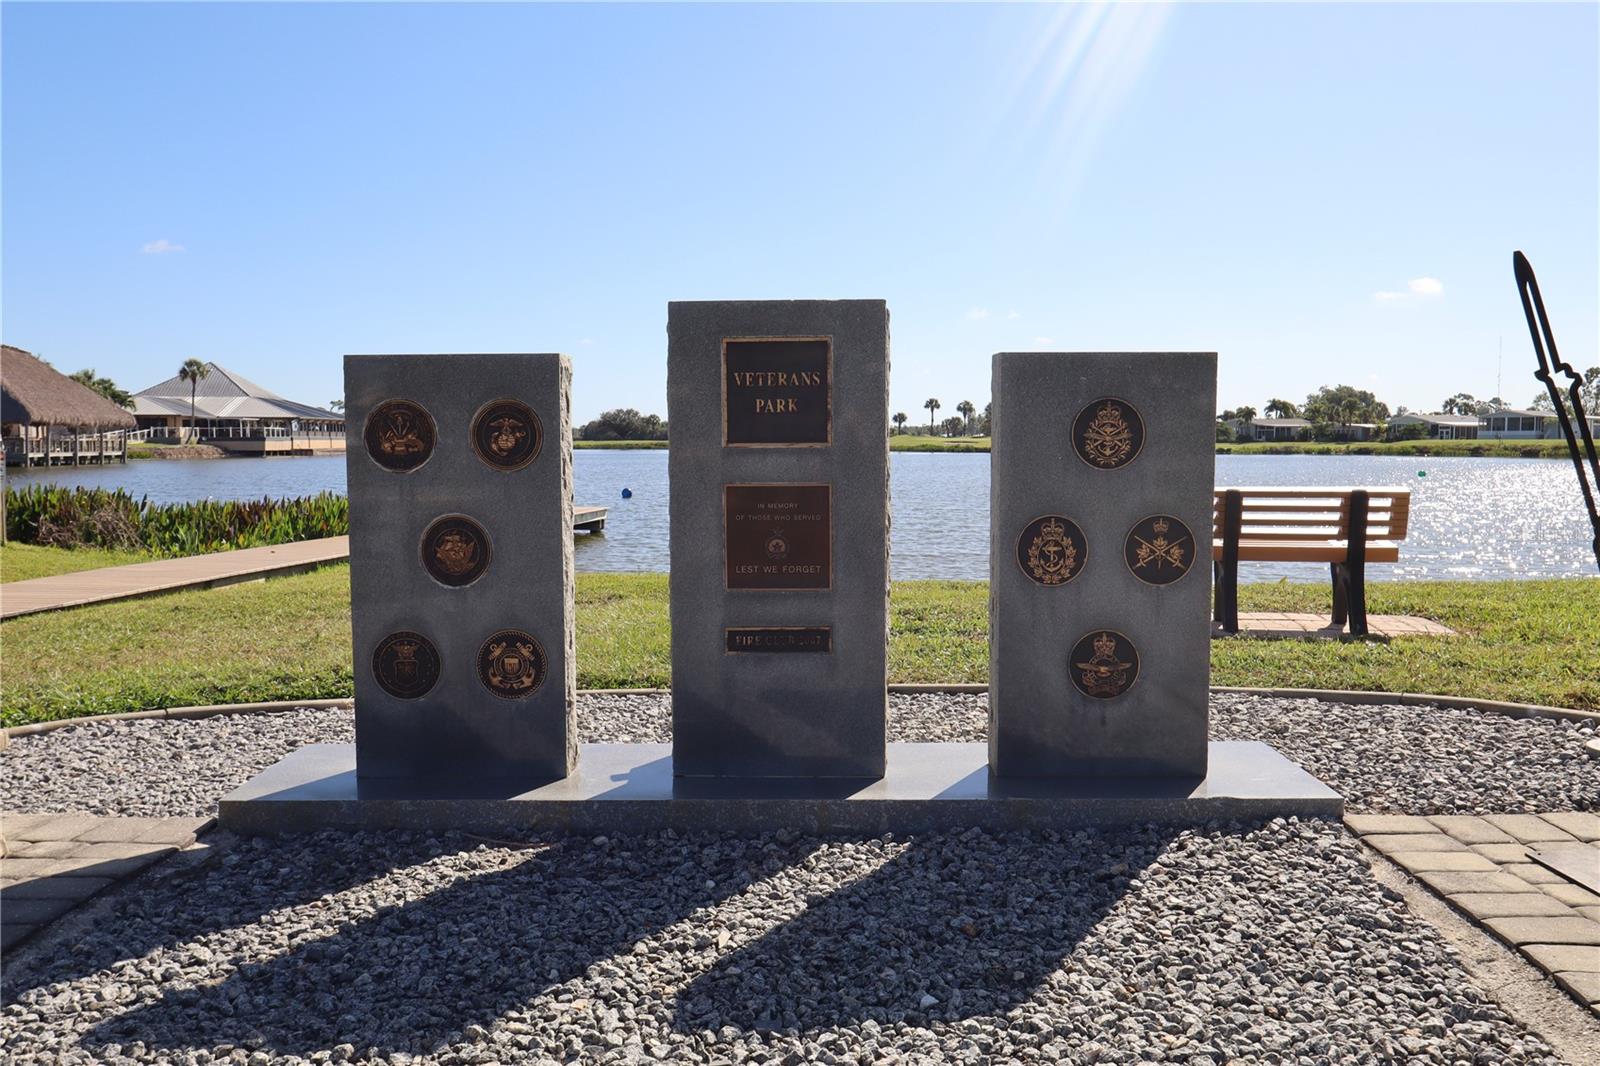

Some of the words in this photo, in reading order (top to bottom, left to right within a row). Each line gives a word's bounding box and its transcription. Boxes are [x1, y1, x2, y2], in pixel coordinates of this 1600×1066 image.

[733, 371, 821, 386] VETERANS
[755, 398, 798, 413] PARK
[735, 565, 759, 574] LEST
[763, 565, 778, 574] WE
[782, 565, 822, 574] FORGET
